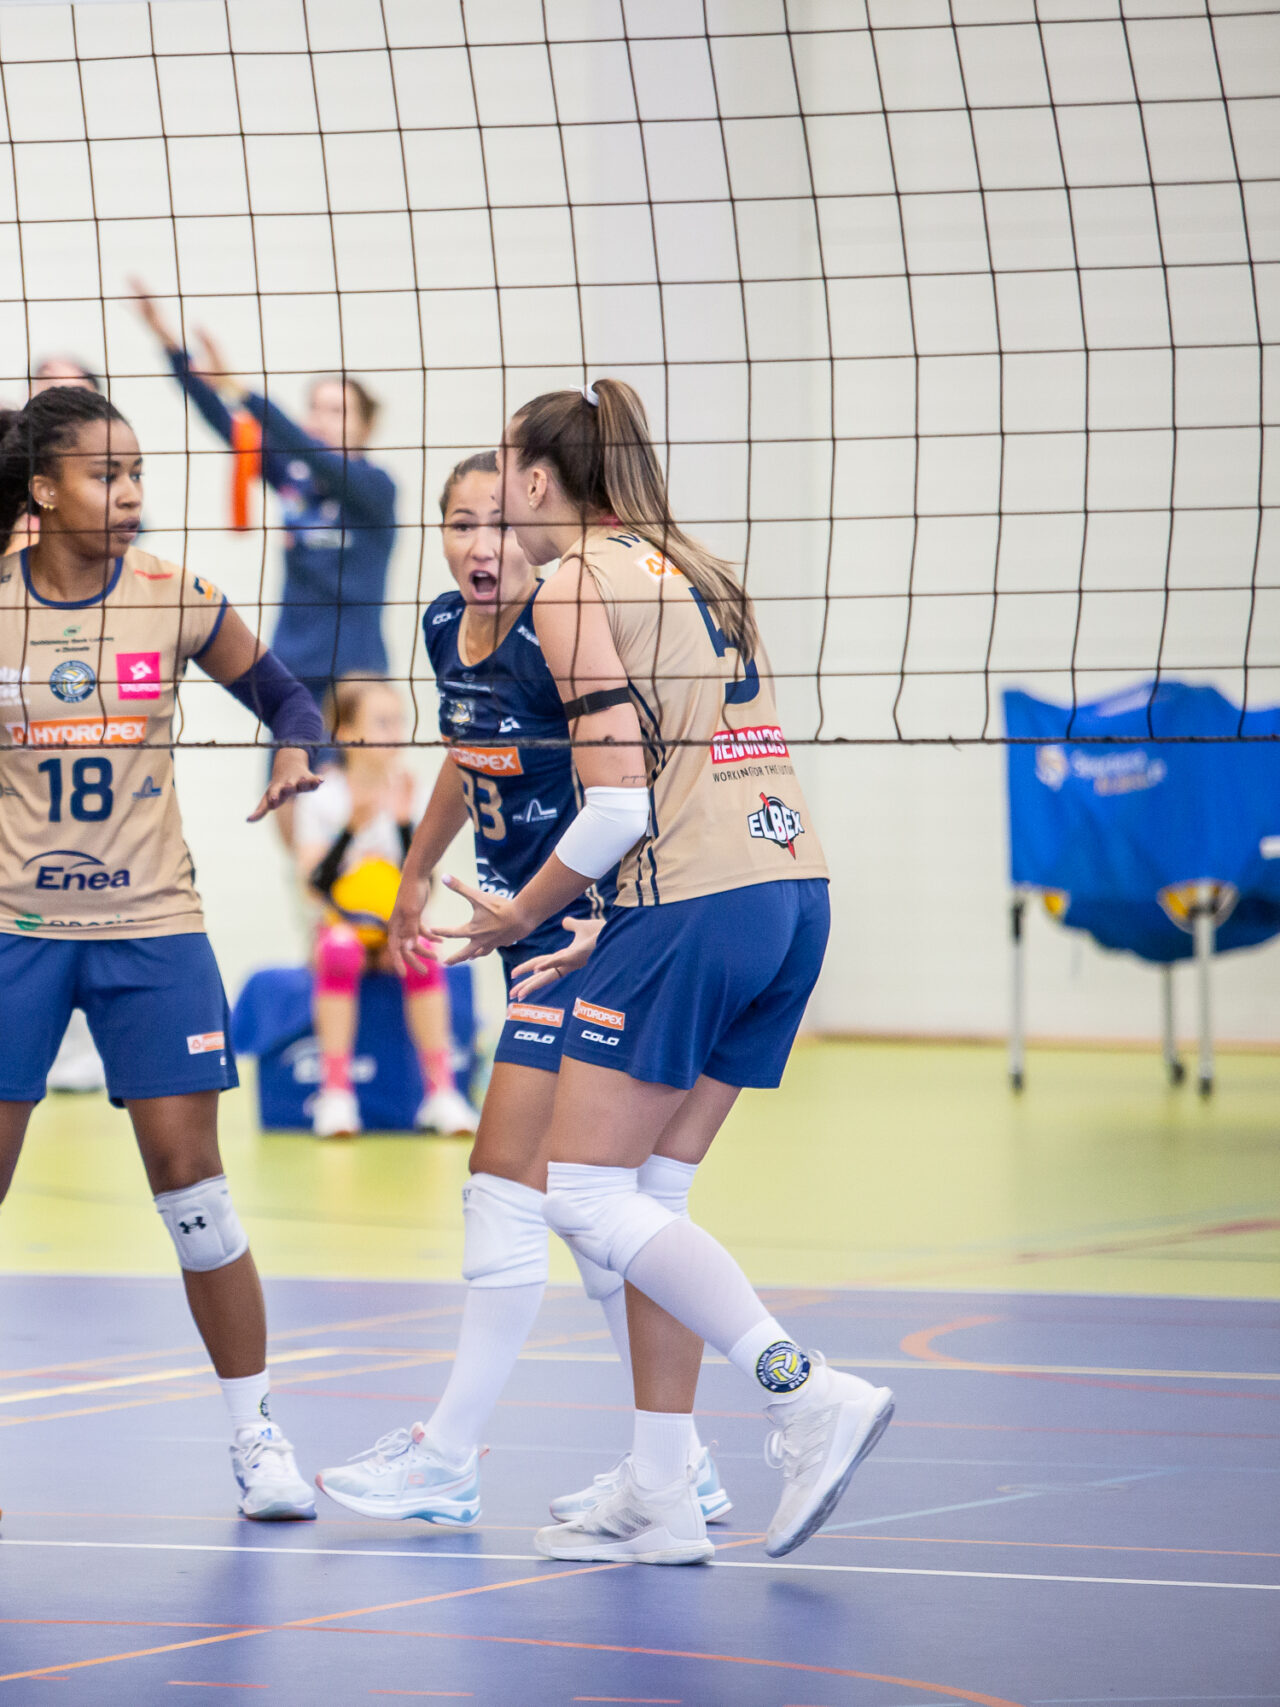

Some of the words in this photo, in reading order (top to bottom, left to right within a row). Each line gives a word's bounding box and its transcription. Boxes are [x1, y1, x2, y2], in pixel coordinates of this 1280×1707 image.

[35, 722, 145, 744] HYDROPEX
[38, 756, 114, 823] 18
[748, 804, 805, 841] ELBEX
[35, 866, 131, 891] Enea
[513, 1030, 556, 1044] COLO
[581, 1029, 620, 1046] COLO
